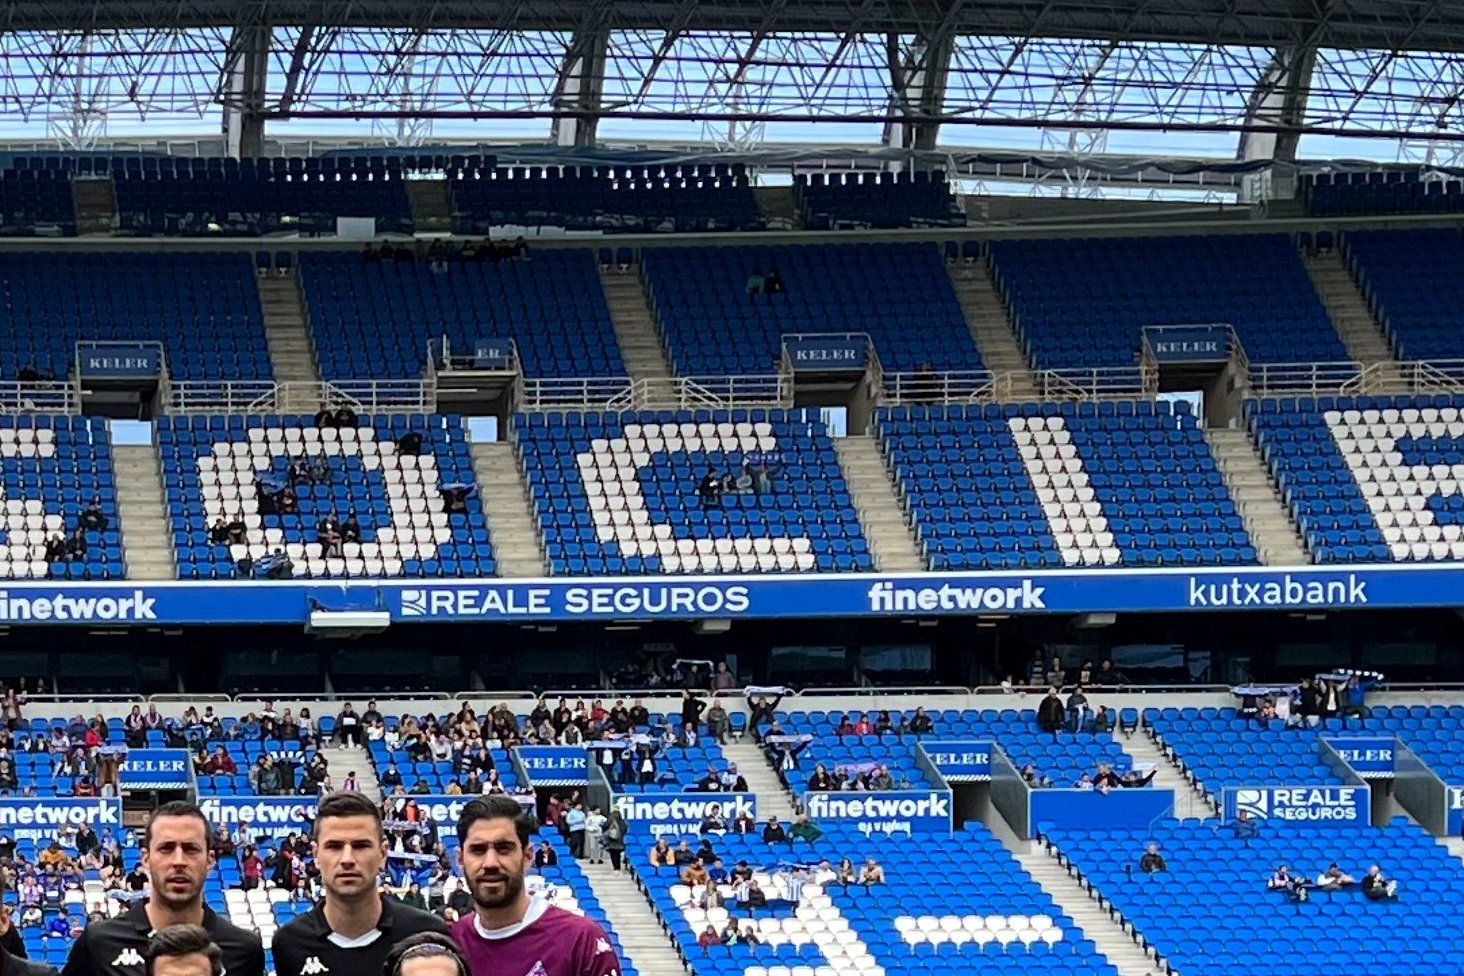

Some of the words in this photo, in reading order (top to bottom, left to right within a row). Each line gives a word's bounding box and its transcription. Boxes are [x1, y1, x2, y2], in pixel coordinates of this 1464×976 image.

[796, 348, 856, 361] KELER
[1156, 340, 1218, 353] KELER
[89, 357, 149, 369] KELER
[867, 578, 1046, 612] finetwork
[1188, 573, 1368, 606] kutxabank
[424, 590, 551, 615] REALE
[566, 588, 750, 615] SEGUROS
[929, 752, 989, 765] ELER
[1337, 749, 1393, 762] ELER
[1273, 788, 1356, 806] REALE
[616, 795, 754, 820] finetwork
[808, 793, 949, 818] finetwork
[1273, 806, 1357, 820] SEGUROS
